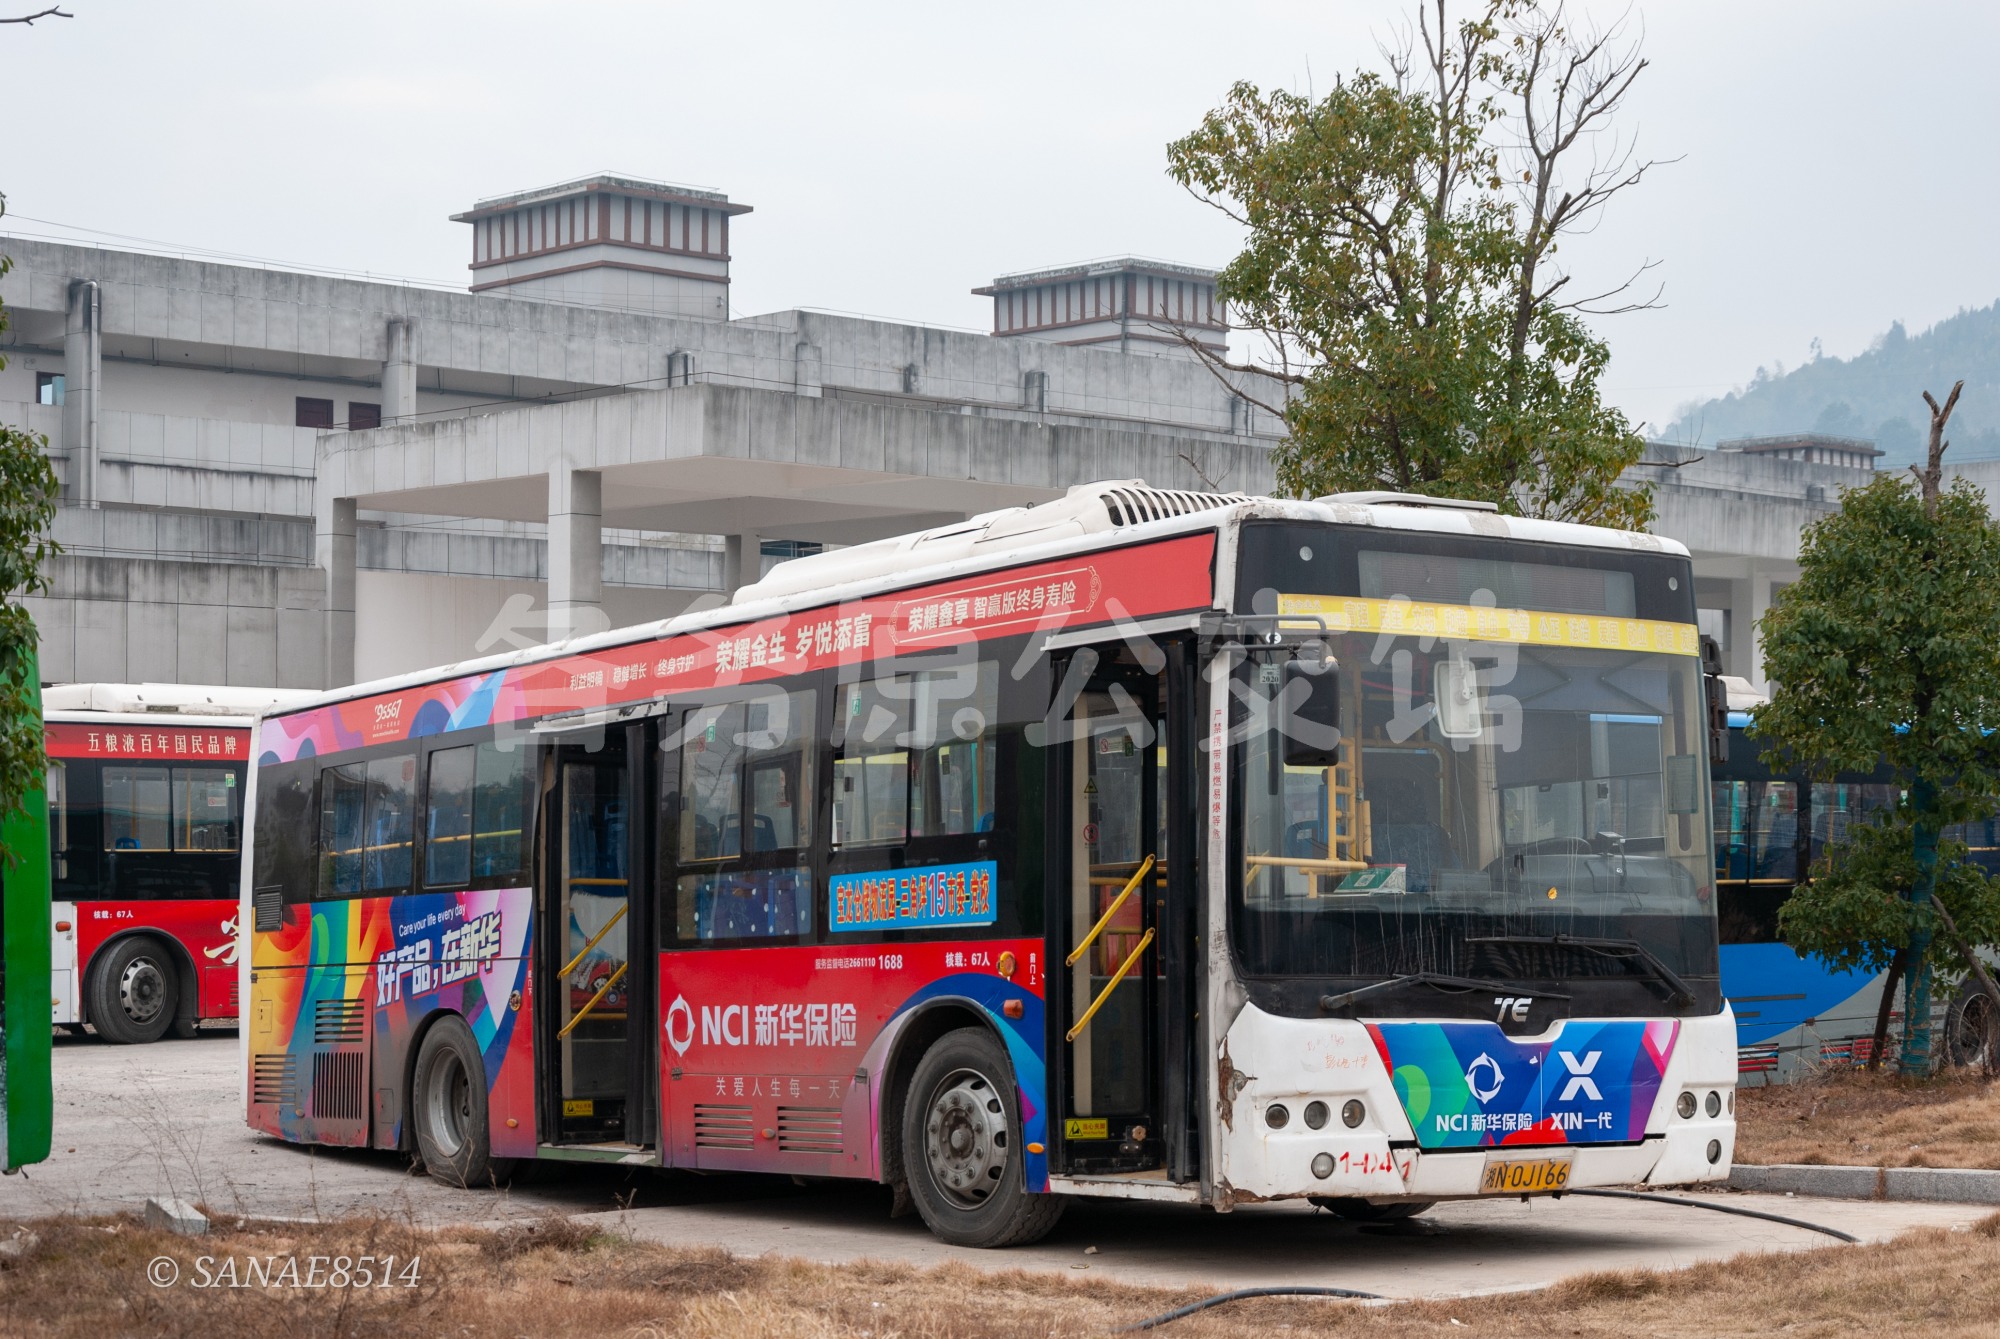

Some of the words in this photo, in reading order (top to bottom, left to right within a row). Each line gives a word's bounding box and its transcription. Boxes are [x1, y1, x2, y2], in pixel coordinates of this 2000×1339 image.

[908, 598, 970, 633] 荣耀鑫享
[974, 580, 1077, 621] 智赢版终身寿险
[1344, 601, 1370, 628] 富强
[1378, 603, 1403, 630] 民主
[1412, 605, 1436, 633] 文明
[1477, 609, 1499, 637] 自由
[1539, 616, 1561, 641] 公正
[1568, 617, 1591, 643] 法治
[1598, 620, 1620, 646] 爱国
[715, 631, 787, 674] 荣耀金生
[795, 613, 872, 661] 岁悦添富
[613, 662, 648, 684] 稳健增长
[657, 654, 695, 675] 终身守护
[570, 671, 604, 691] 利益明确
[1262, 675, 1279, 683] 2020
[88, 733, 237, 755] 五粮液百年国民品牌
[399, 924, 414, 937] Care
[413, 918, 427, 935] your
[427, 913, 437, 927] life
[437, 908, 455, 924] every
[455, 903, 467, 918] day
[878, 954, 903, 970] 1688
[702, 1004, 749, 1046] NCI
[754, 1003, 857, 1047] 新华保险
[716, 1076, 840, 1099] 关爱人生每一天
[1436, 1114, 1468, 1132] NCI
[1471, 1113, 1532, 1131] 新华保险
